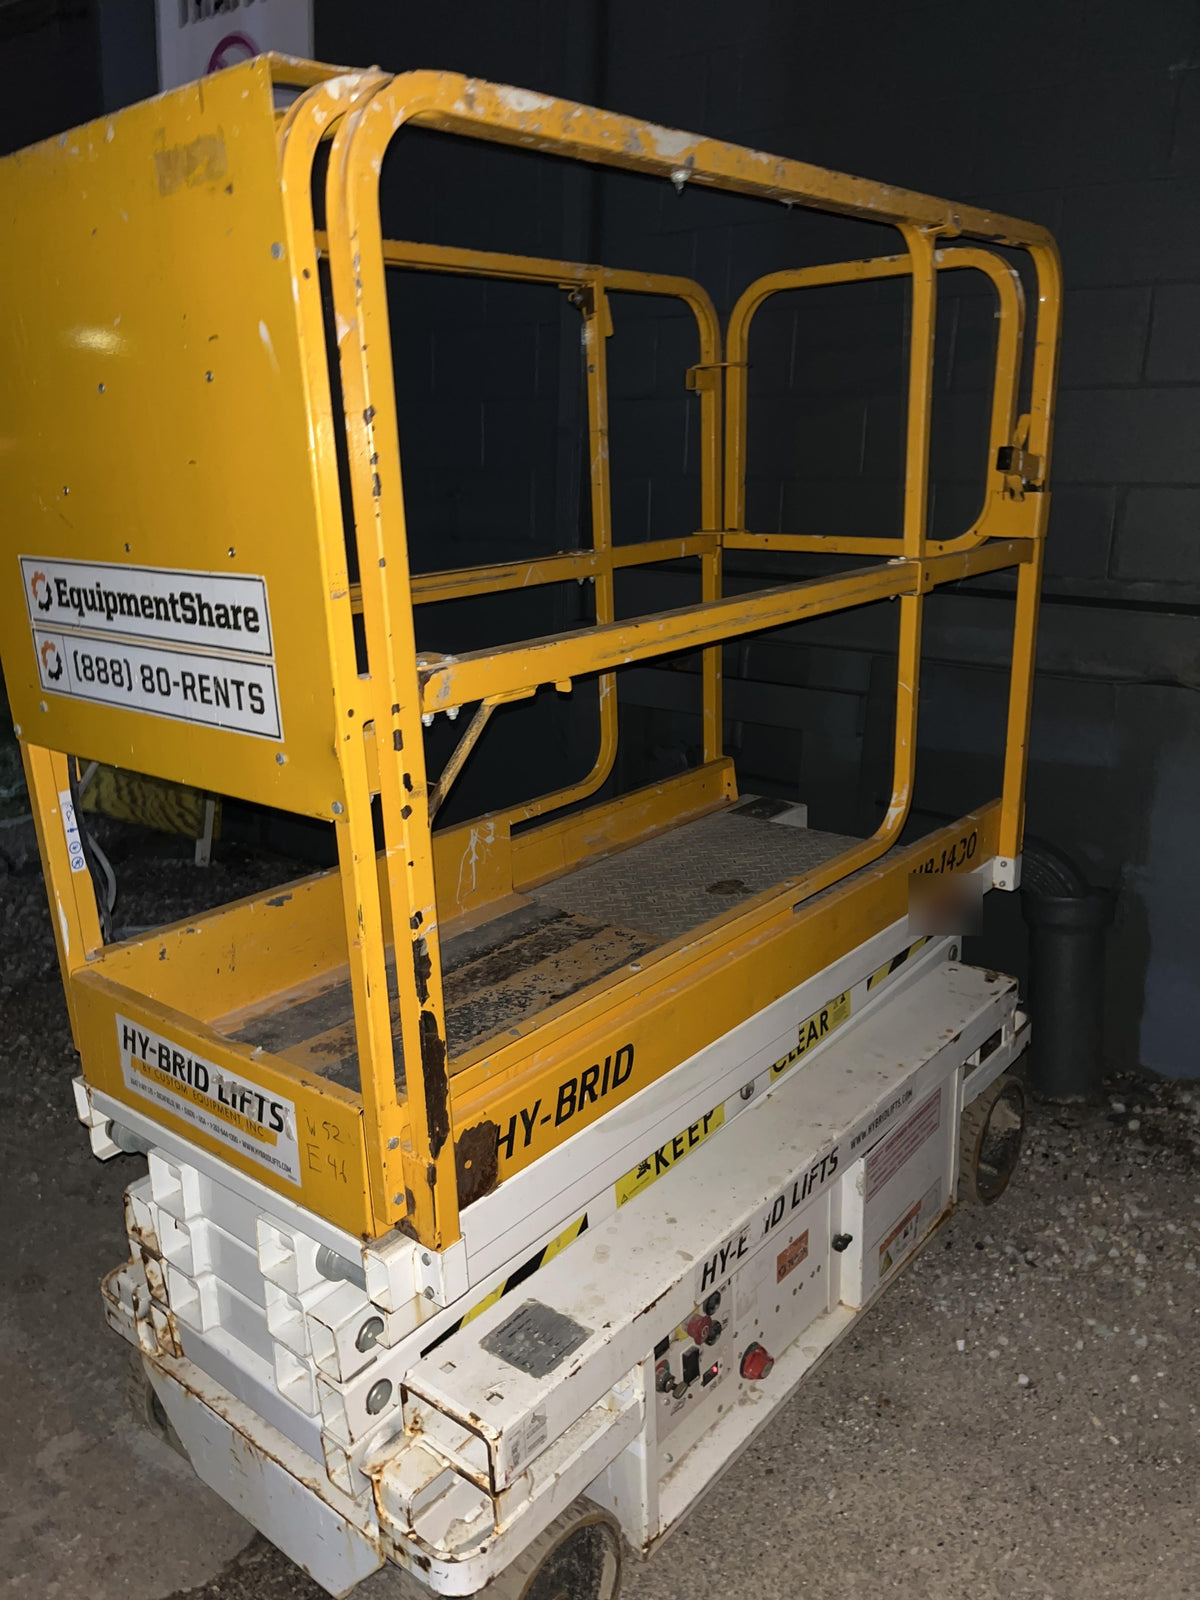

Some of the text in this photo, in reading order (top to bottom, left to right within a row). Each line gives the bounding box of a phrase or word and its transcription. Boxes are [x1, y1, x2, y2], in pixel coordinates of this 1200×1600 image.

[54, 577, 260, 633] EquipmentShare
[74, 650, 265, 715] (888) 80-RENTS
[123, 1024, 209, 1093] HY-BRID
[217, 1078, 284, 1133] LIFTS
[154, 1067, 188, 1094] CUSTOM
[192, 1089, 241, 1124] EQUIPMENT
[246, 1119, 264, 1137] INC
[496, 1043, 635, 1160] HY-BRID
[306, 1142, 321, 1173] E
[791, 1146, 839, 1210] LIFTS
